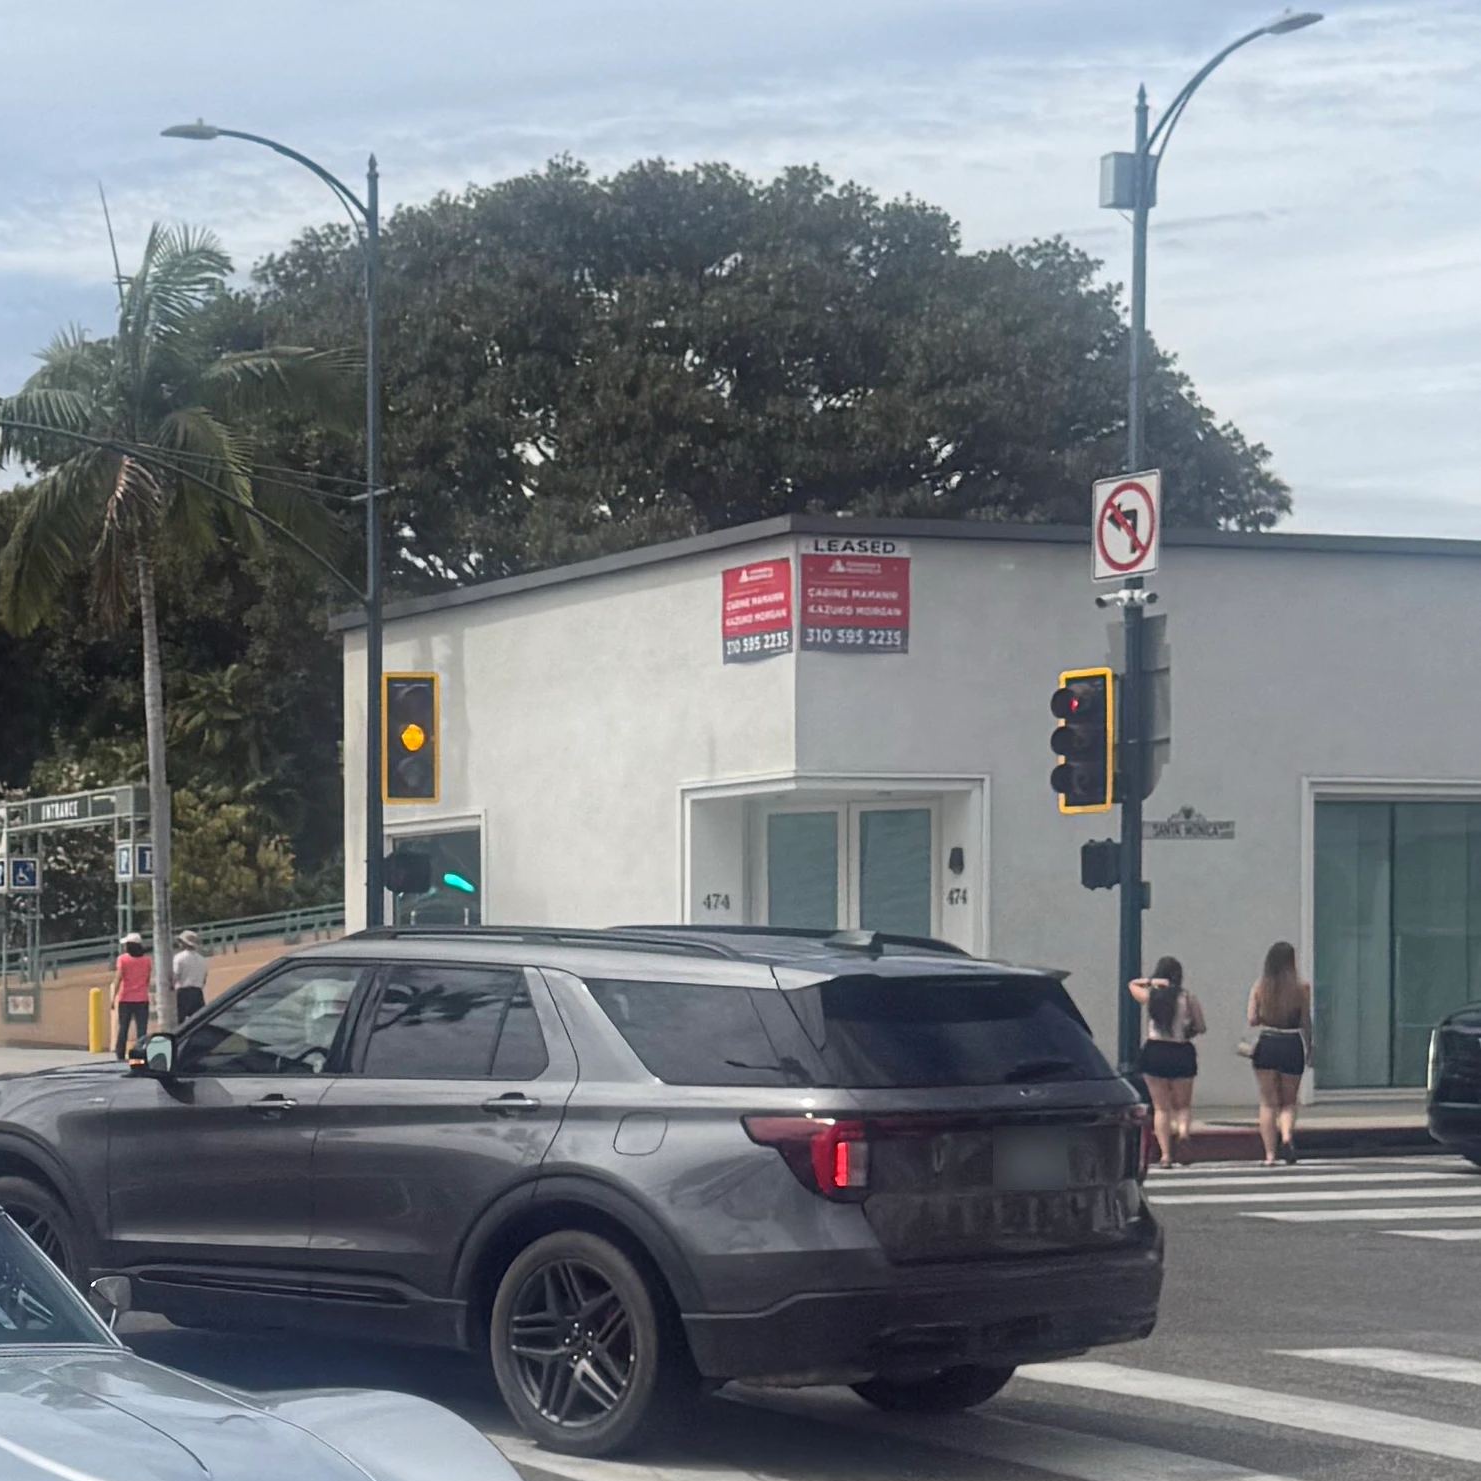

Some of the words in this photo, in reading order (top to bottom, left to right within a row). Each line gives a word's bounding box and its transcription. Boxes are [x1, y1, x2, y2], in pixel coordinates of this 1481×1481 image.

[814, 539, 896, 554] LEASED
[763, 631, 789, 649] 2235
[806, 628, 833, 643] 310
[836, 629, 864, 644] 595
[868, 630, 902, 646] 2235
[41, 800, 78, 821] ENTRANCE
[1152, 822, 1181, 837] SANTA
[1184, 822, 1219, 837] MONICA
[702, 893, 731, 910] 474
[946, 888, 968, 906] 474
